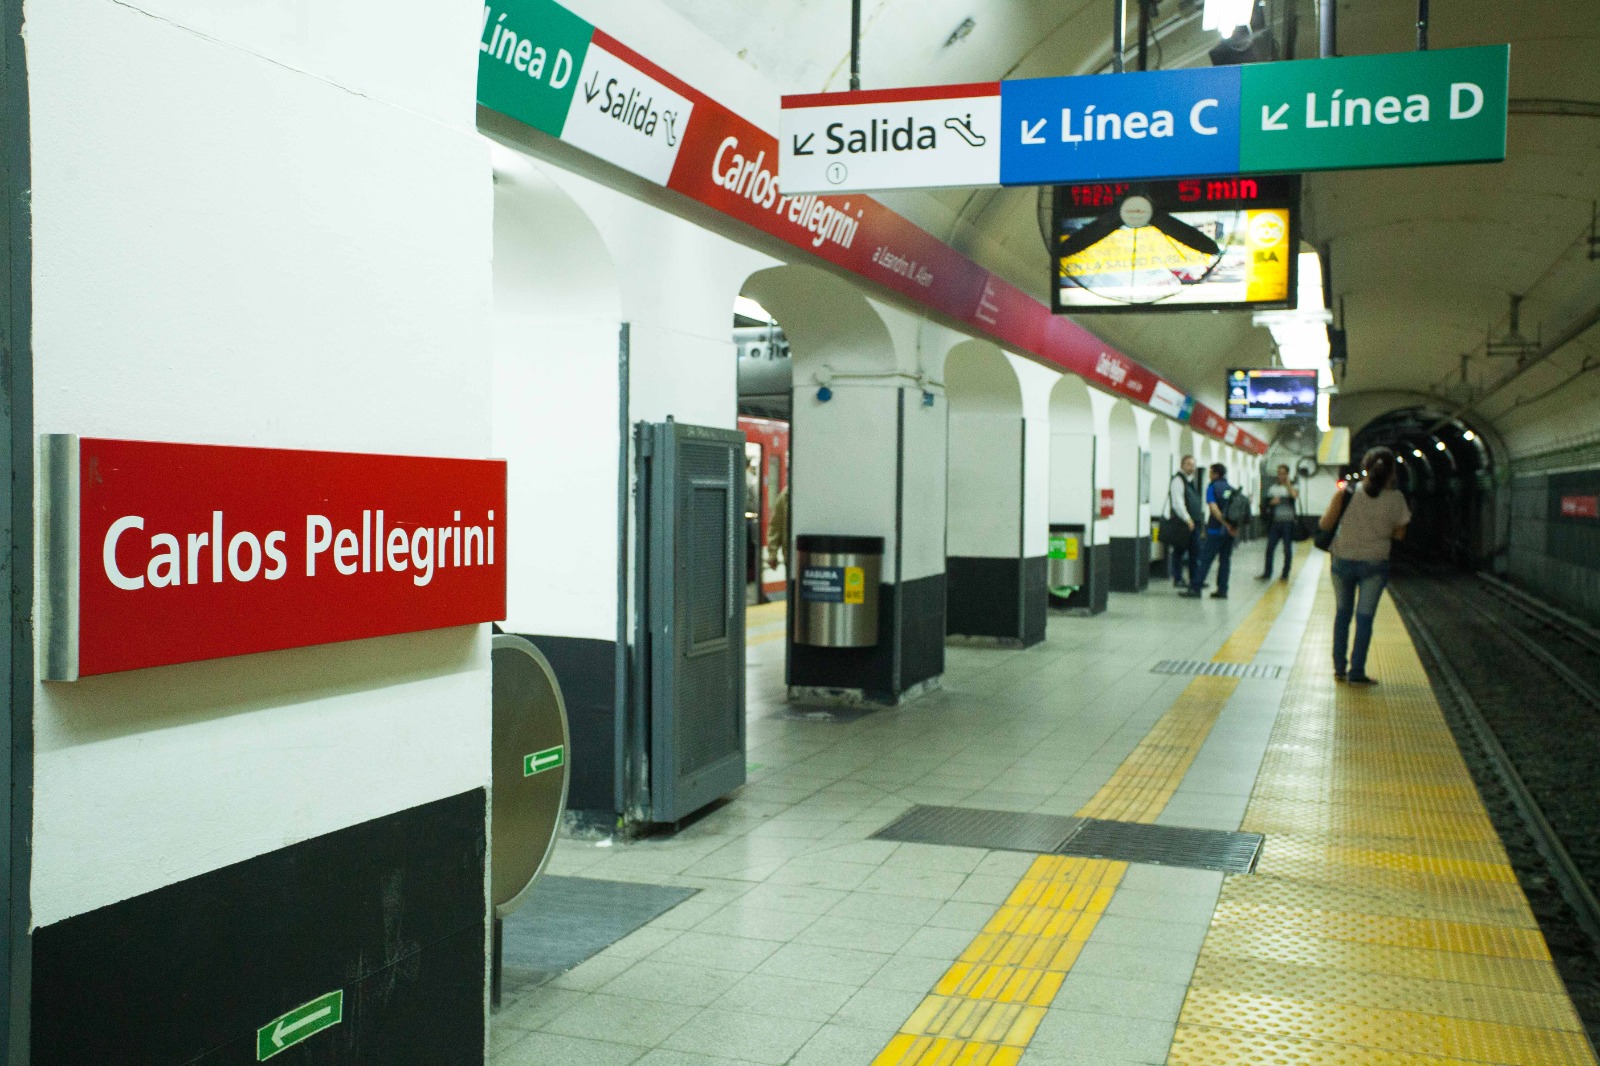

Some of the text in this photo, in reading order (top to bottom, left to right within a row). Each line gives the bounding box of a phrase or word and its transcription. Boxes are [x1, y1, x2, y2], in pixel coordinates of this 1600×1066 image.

[480, 5, 573, 90] Línea D
[600, 78, 658, 137] Salida
[1061, 98, 1219, 143] Línea C
[1306, 82, 1484, 128] Línea D
[826, 117, 936, 154] Salida
[712, 136, 779, 209] Carlos
[1178, 178, 1257, 202] 5 min
[103, 510, 495, 591] Carlos Pellegrini
